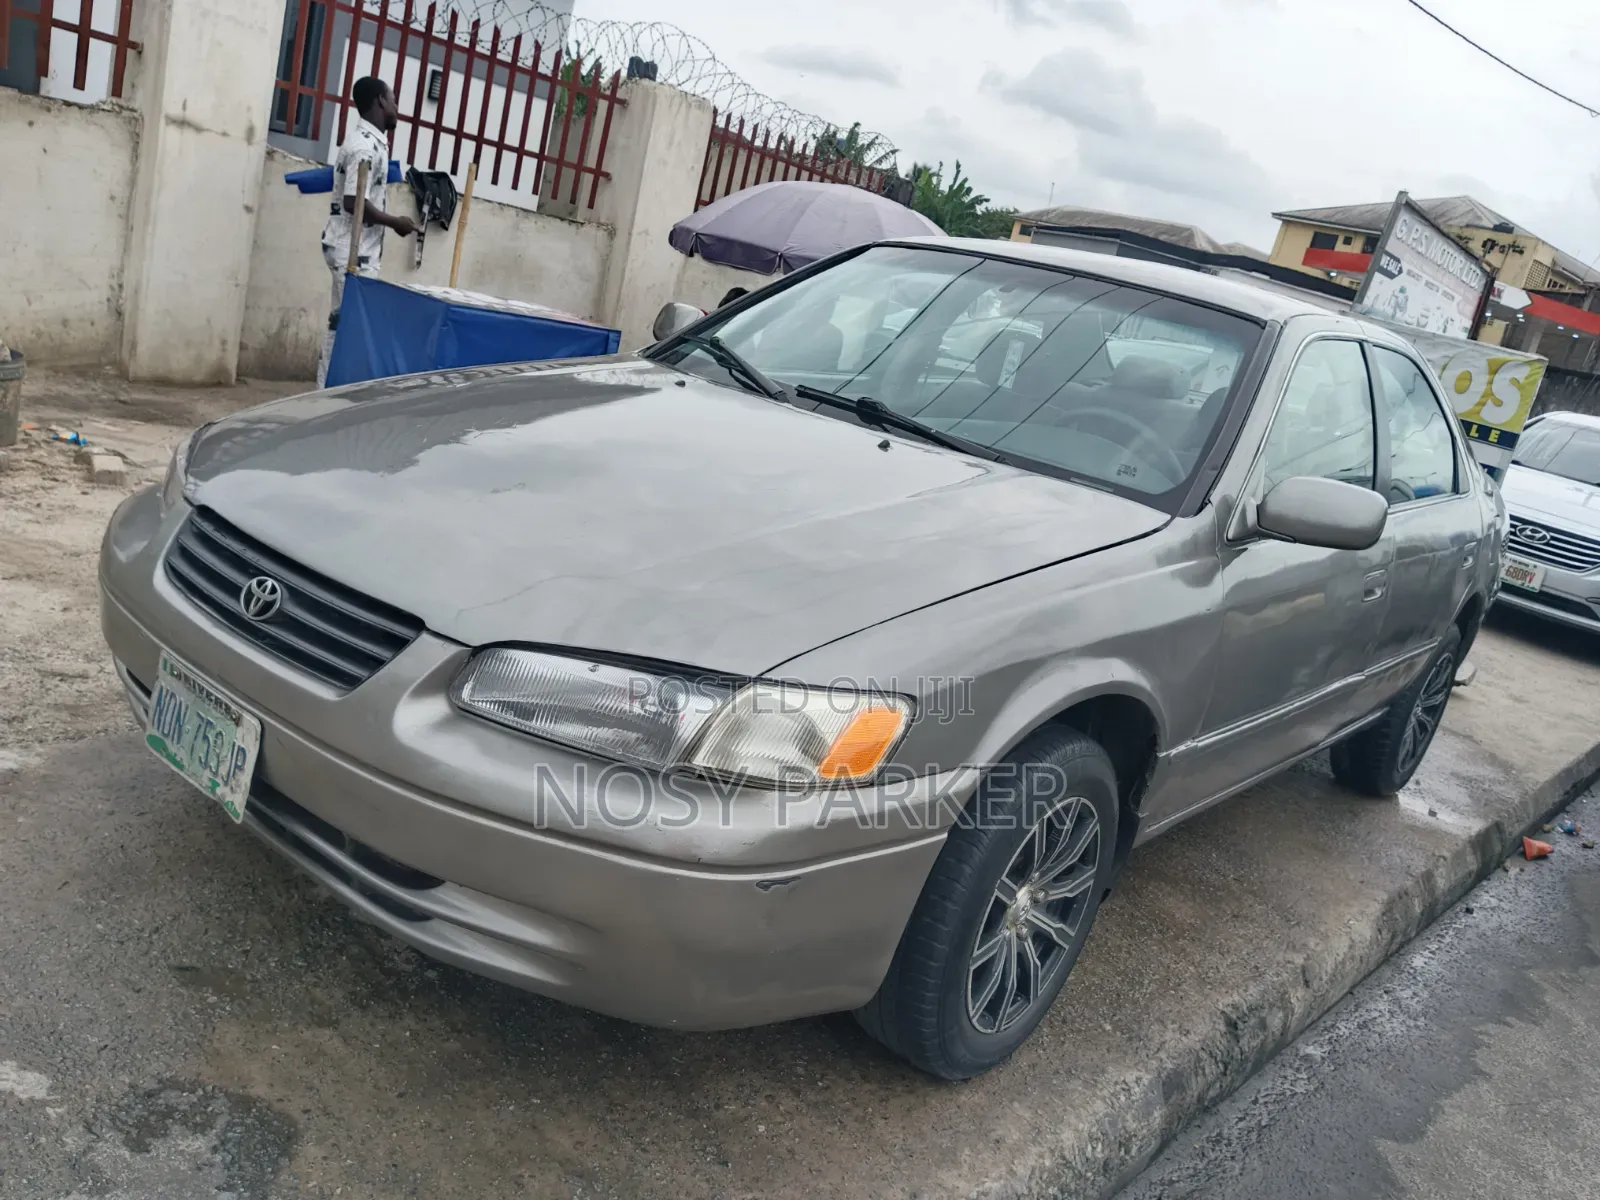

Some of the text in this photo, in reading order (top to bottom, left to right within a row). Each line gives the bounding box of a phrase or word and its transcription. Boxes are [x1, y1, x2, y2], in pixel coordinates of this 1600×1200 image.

[1380, 253, 1390, 269] WE
[1387, 257, 1402, 276] SALE
[1426, 238, 1464, 278] MOTOR
